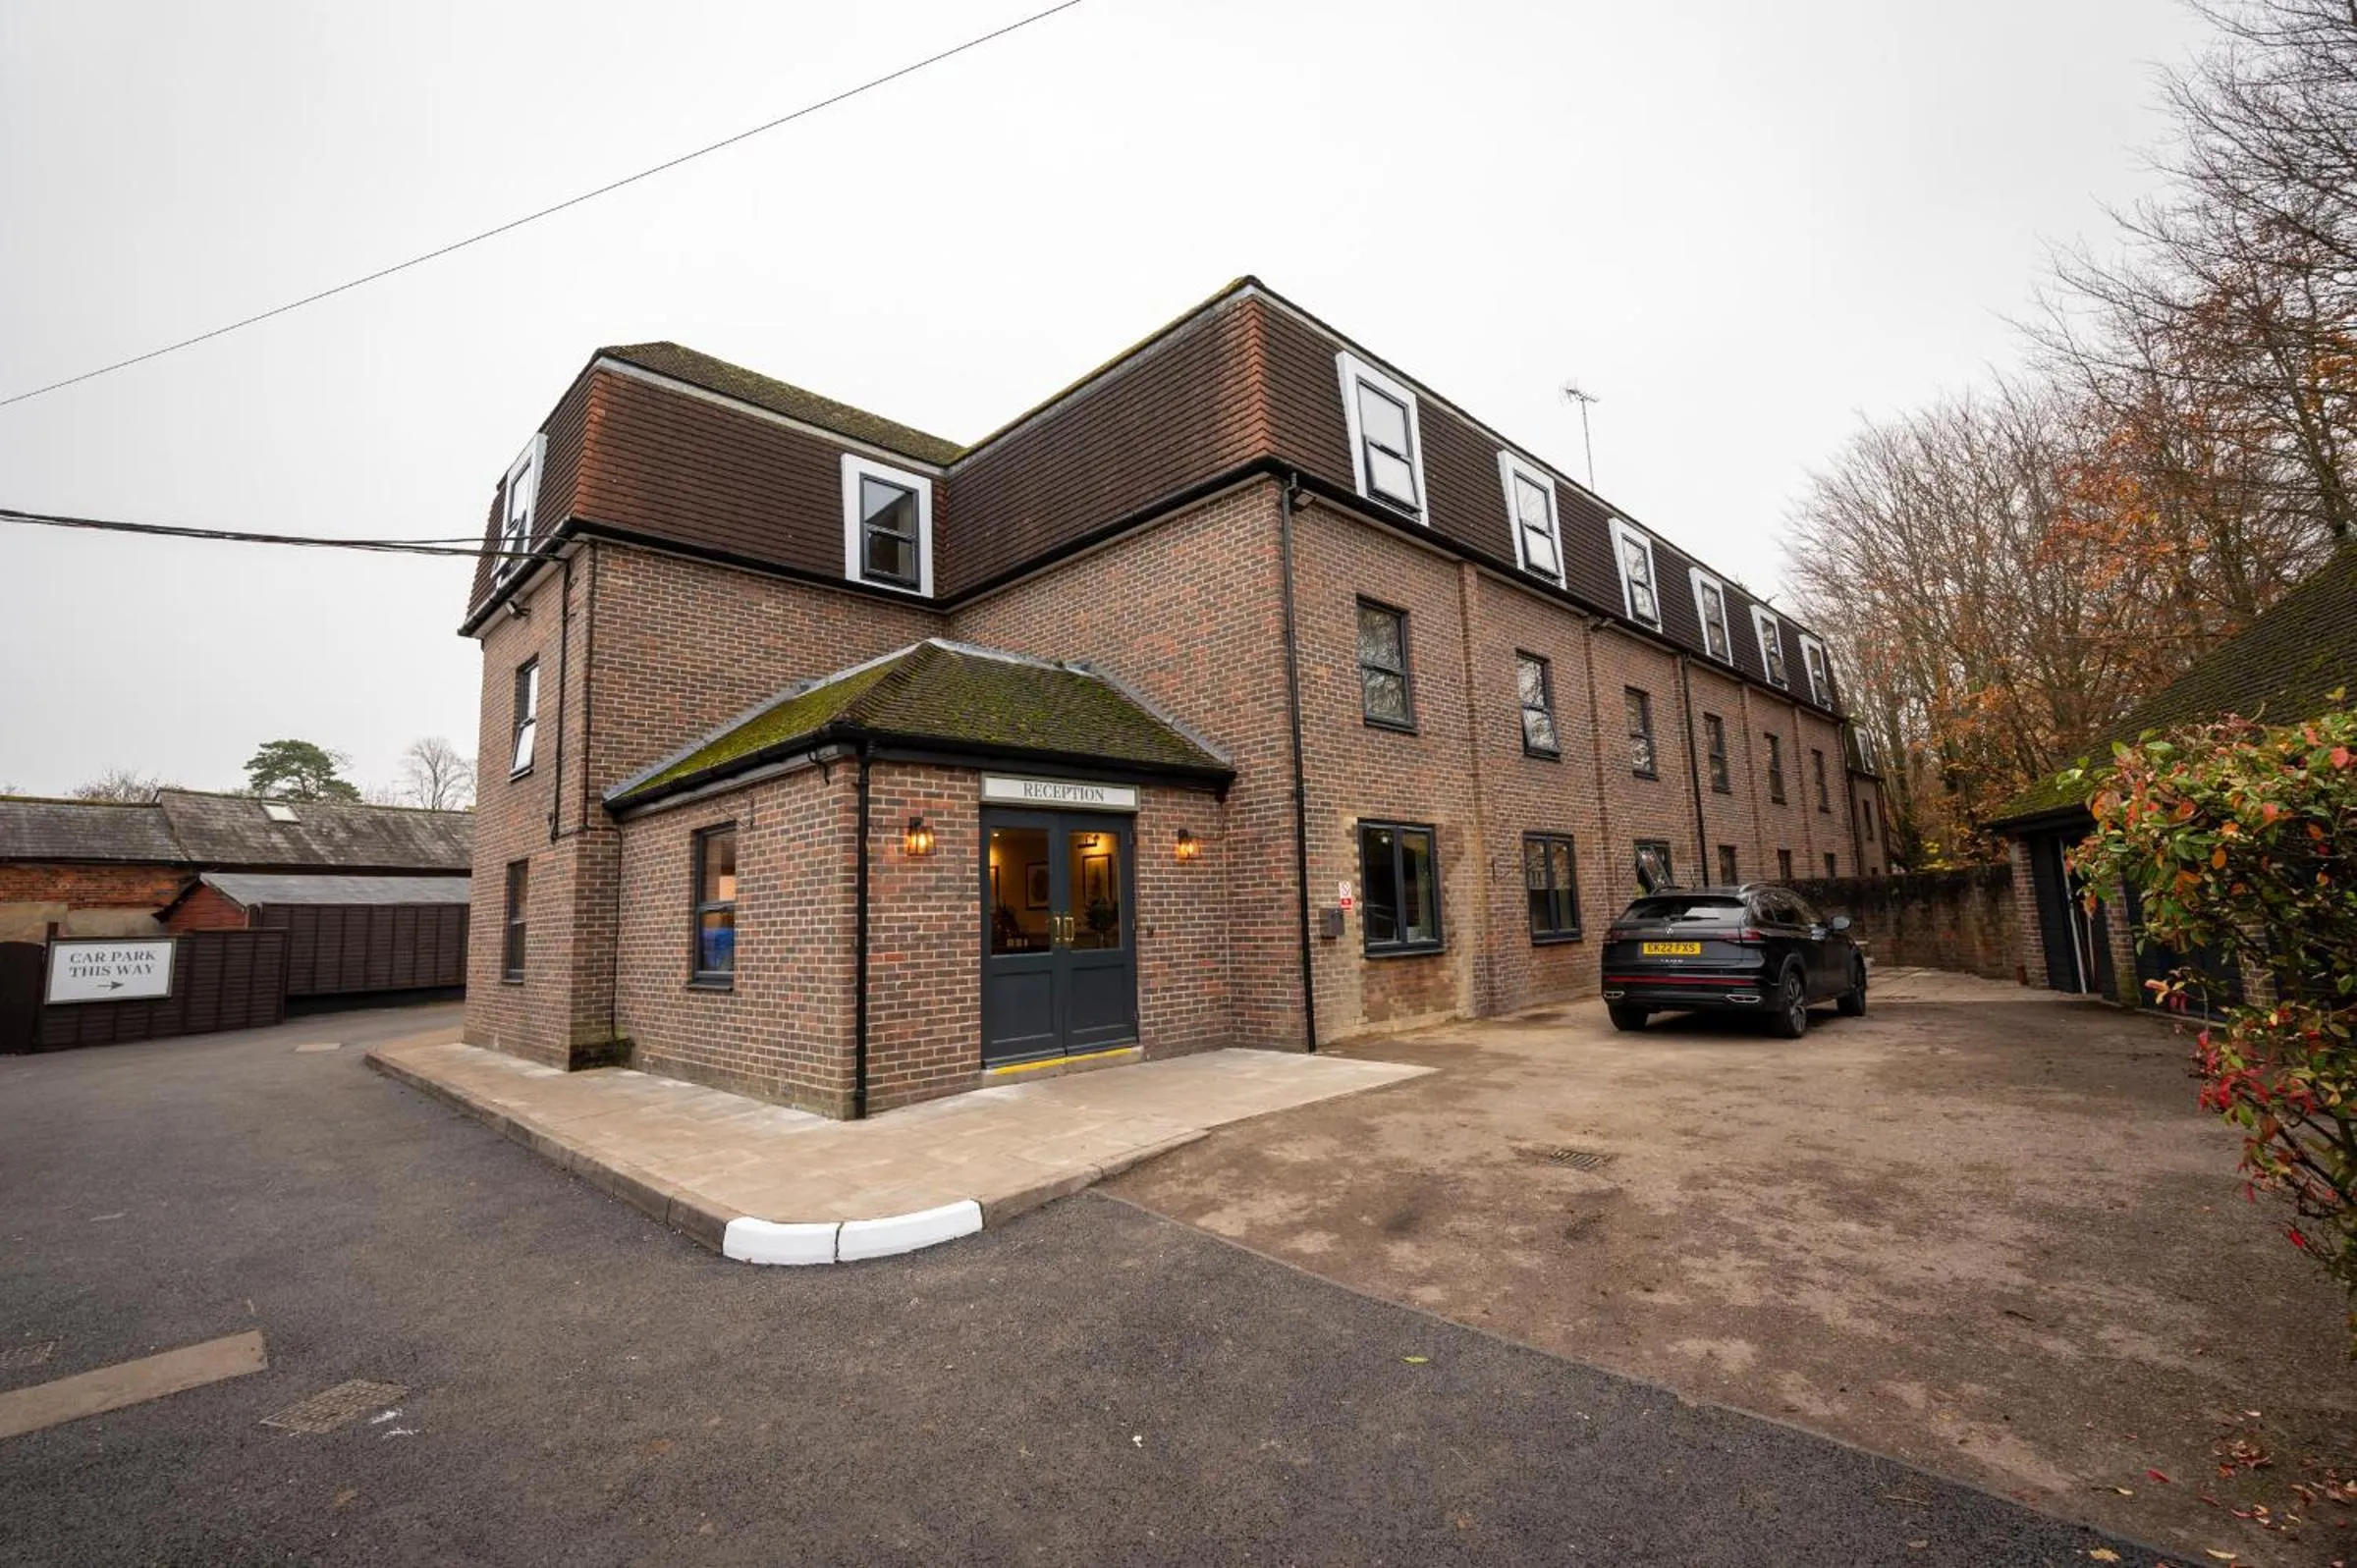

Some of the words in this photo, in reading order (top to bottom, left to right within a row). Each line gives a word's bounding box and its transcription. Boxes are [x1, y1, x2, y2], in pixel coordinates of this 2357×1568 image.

[1022, 782, 1105, 802] RECEPTION
[70, 951, 106, 963] CAR
[111, 949, 155, 962] PARK
[69, 965, 112, 978] THIS
[117, 963, 154, 975] WAY
